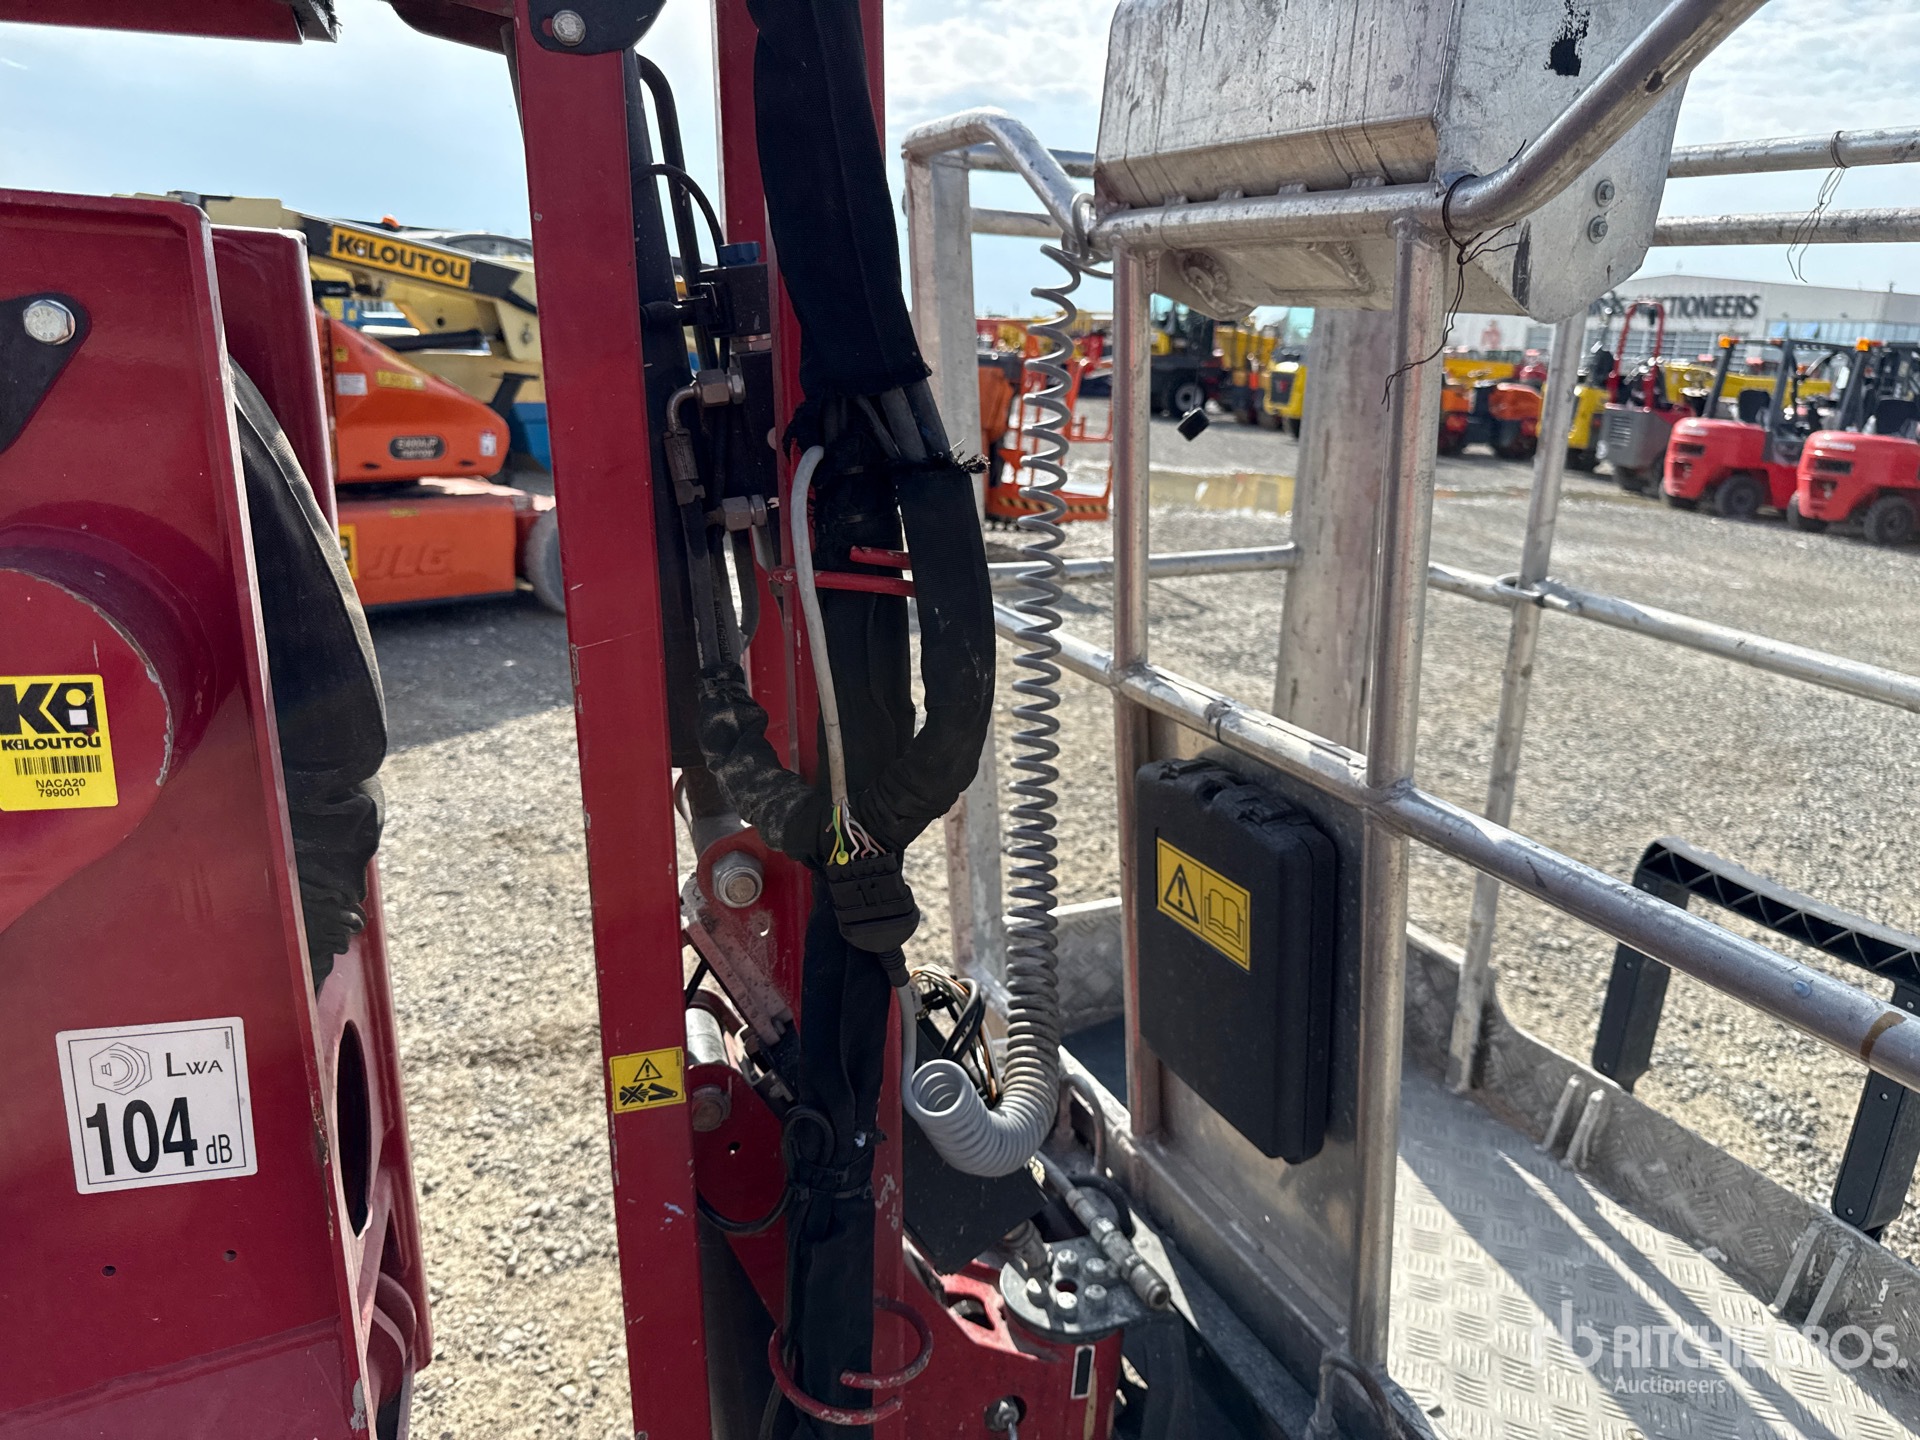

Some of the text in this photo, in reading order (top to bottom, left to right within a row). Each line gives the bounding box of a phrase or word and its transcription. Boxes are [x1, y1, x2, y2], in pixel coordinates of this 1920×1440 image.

[36, 778, 86, 788] NACA20
[38, 788, 80, 797] 799001
[86, 1097, 233, 1176] 104 dB
